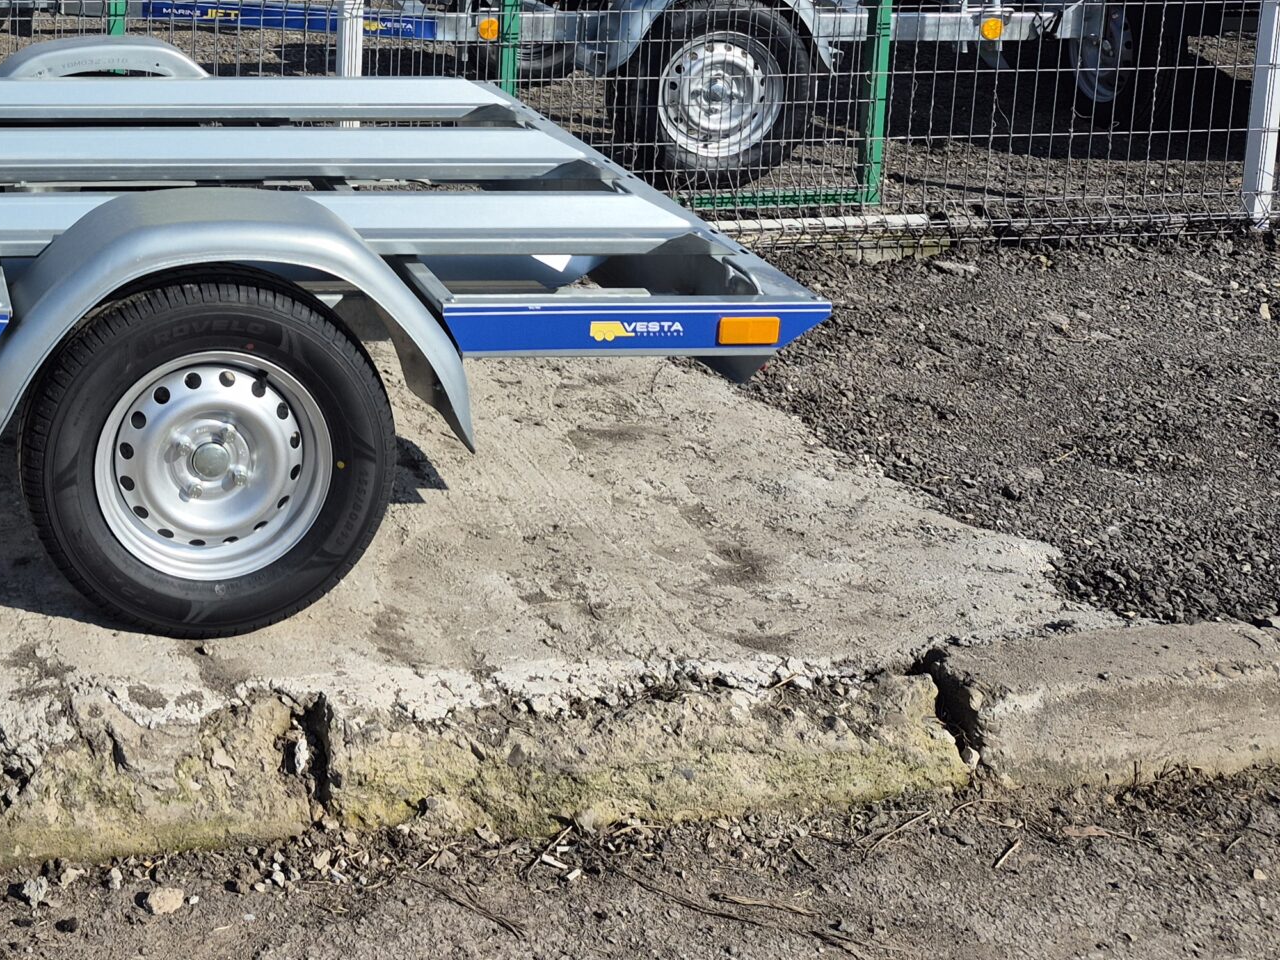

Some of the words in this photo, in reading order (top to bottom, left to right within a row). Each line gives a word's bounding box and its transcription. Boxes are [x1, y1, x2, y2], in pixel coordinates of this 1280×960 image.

[162, 7, 200, 17] MARINE
[380, 21, 413, 29] VESTA
[623, 321, 684, 332] VESTA
